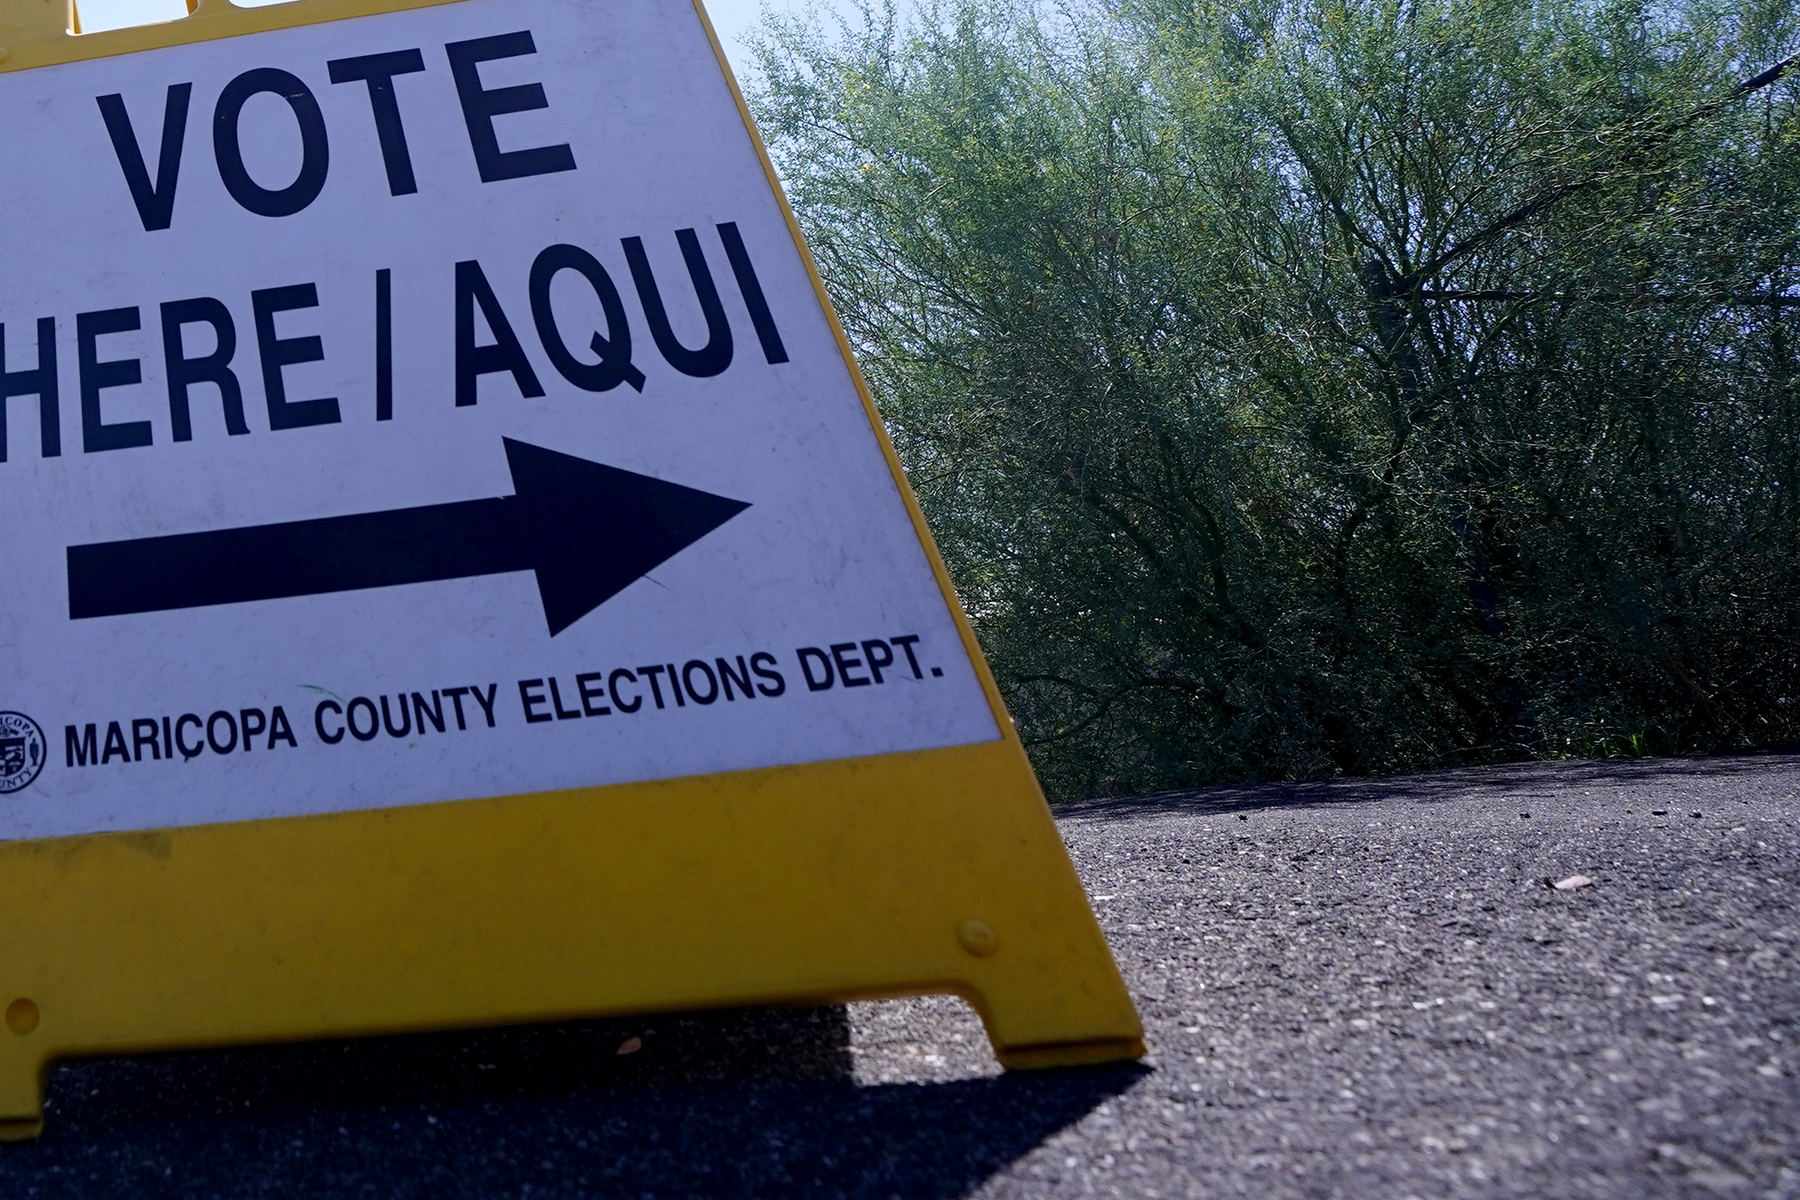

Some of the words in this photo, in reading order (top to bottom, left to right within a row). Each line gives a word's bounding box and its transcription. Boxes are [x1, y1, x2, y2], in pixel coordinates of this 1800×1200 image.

[96, 30, 576, 231] VOTE
[65, 706, 297, 767] MARICOPA
[315, 684, 497, 744] COUNTY
[518, 652, 785, 723] ELECTIONS
[796, 635, 943, 691] DEPT.
